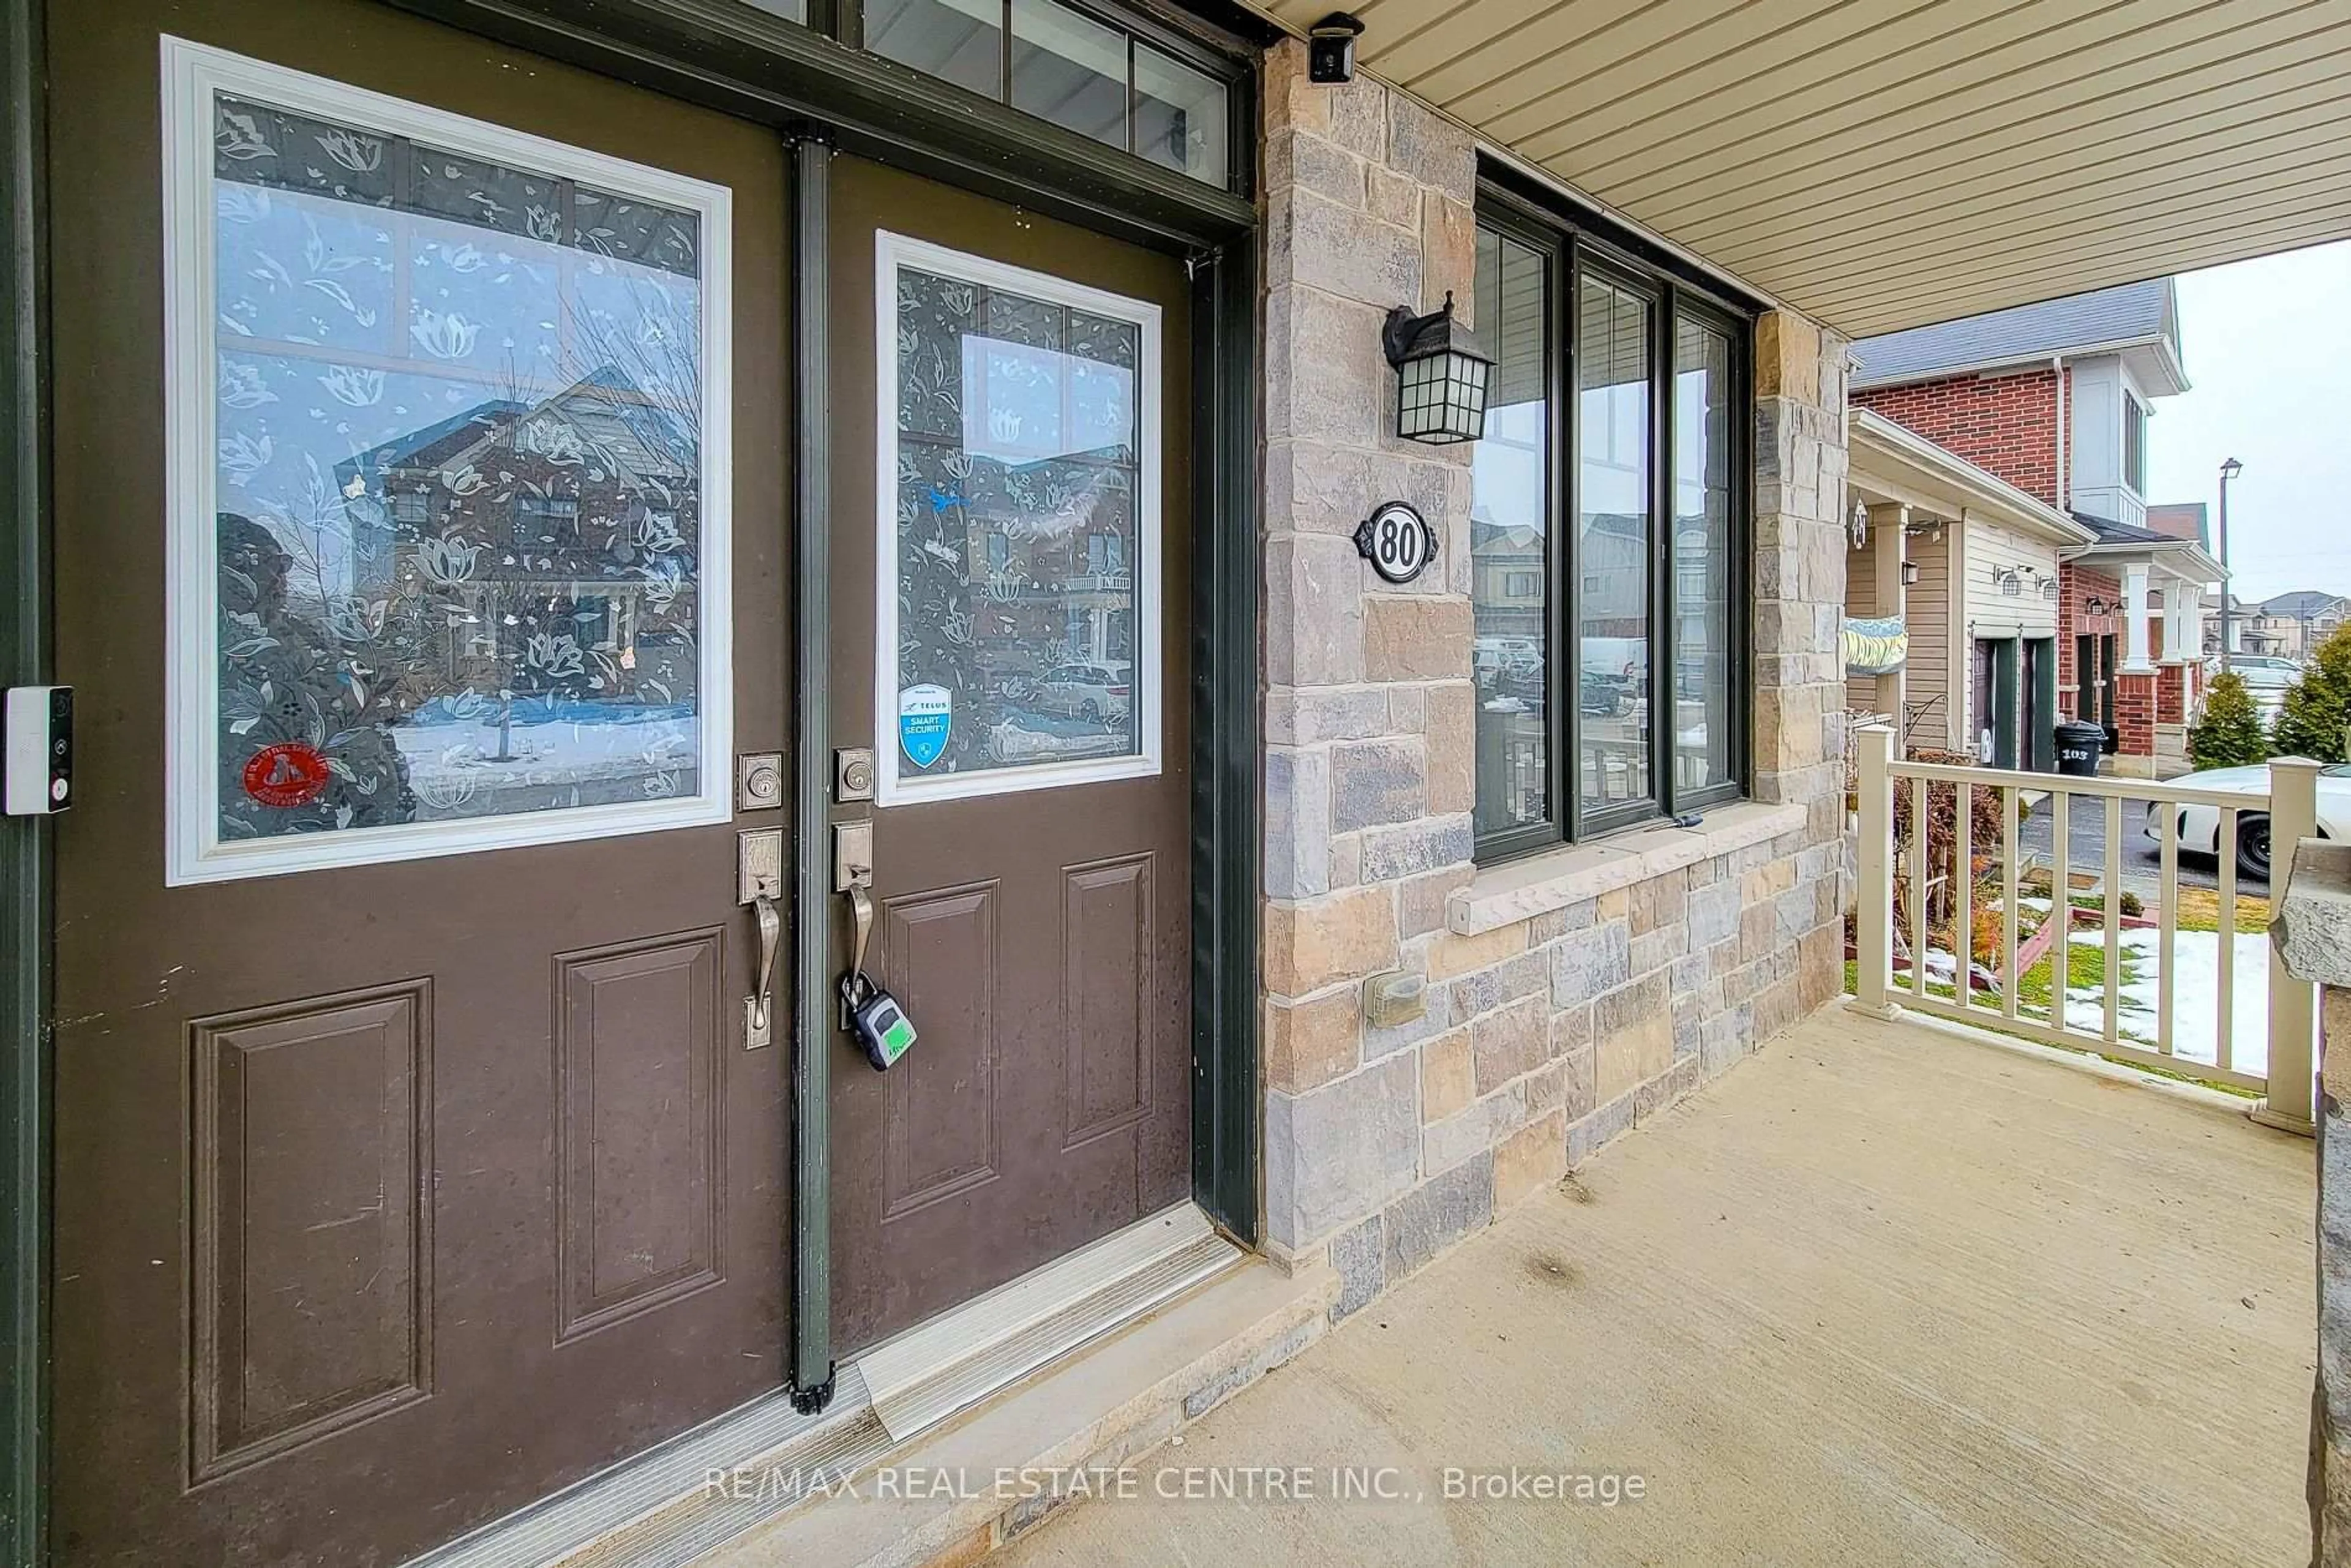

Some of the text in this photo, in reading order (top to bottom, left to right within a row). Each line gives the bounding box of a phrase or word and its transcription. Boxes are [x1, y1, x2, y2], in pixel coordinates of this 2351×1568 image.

[1381, 519, 1415, 566] 80
[910, 716, 939, 726] SMART
[905, 725, 945, 734] SECURITY
